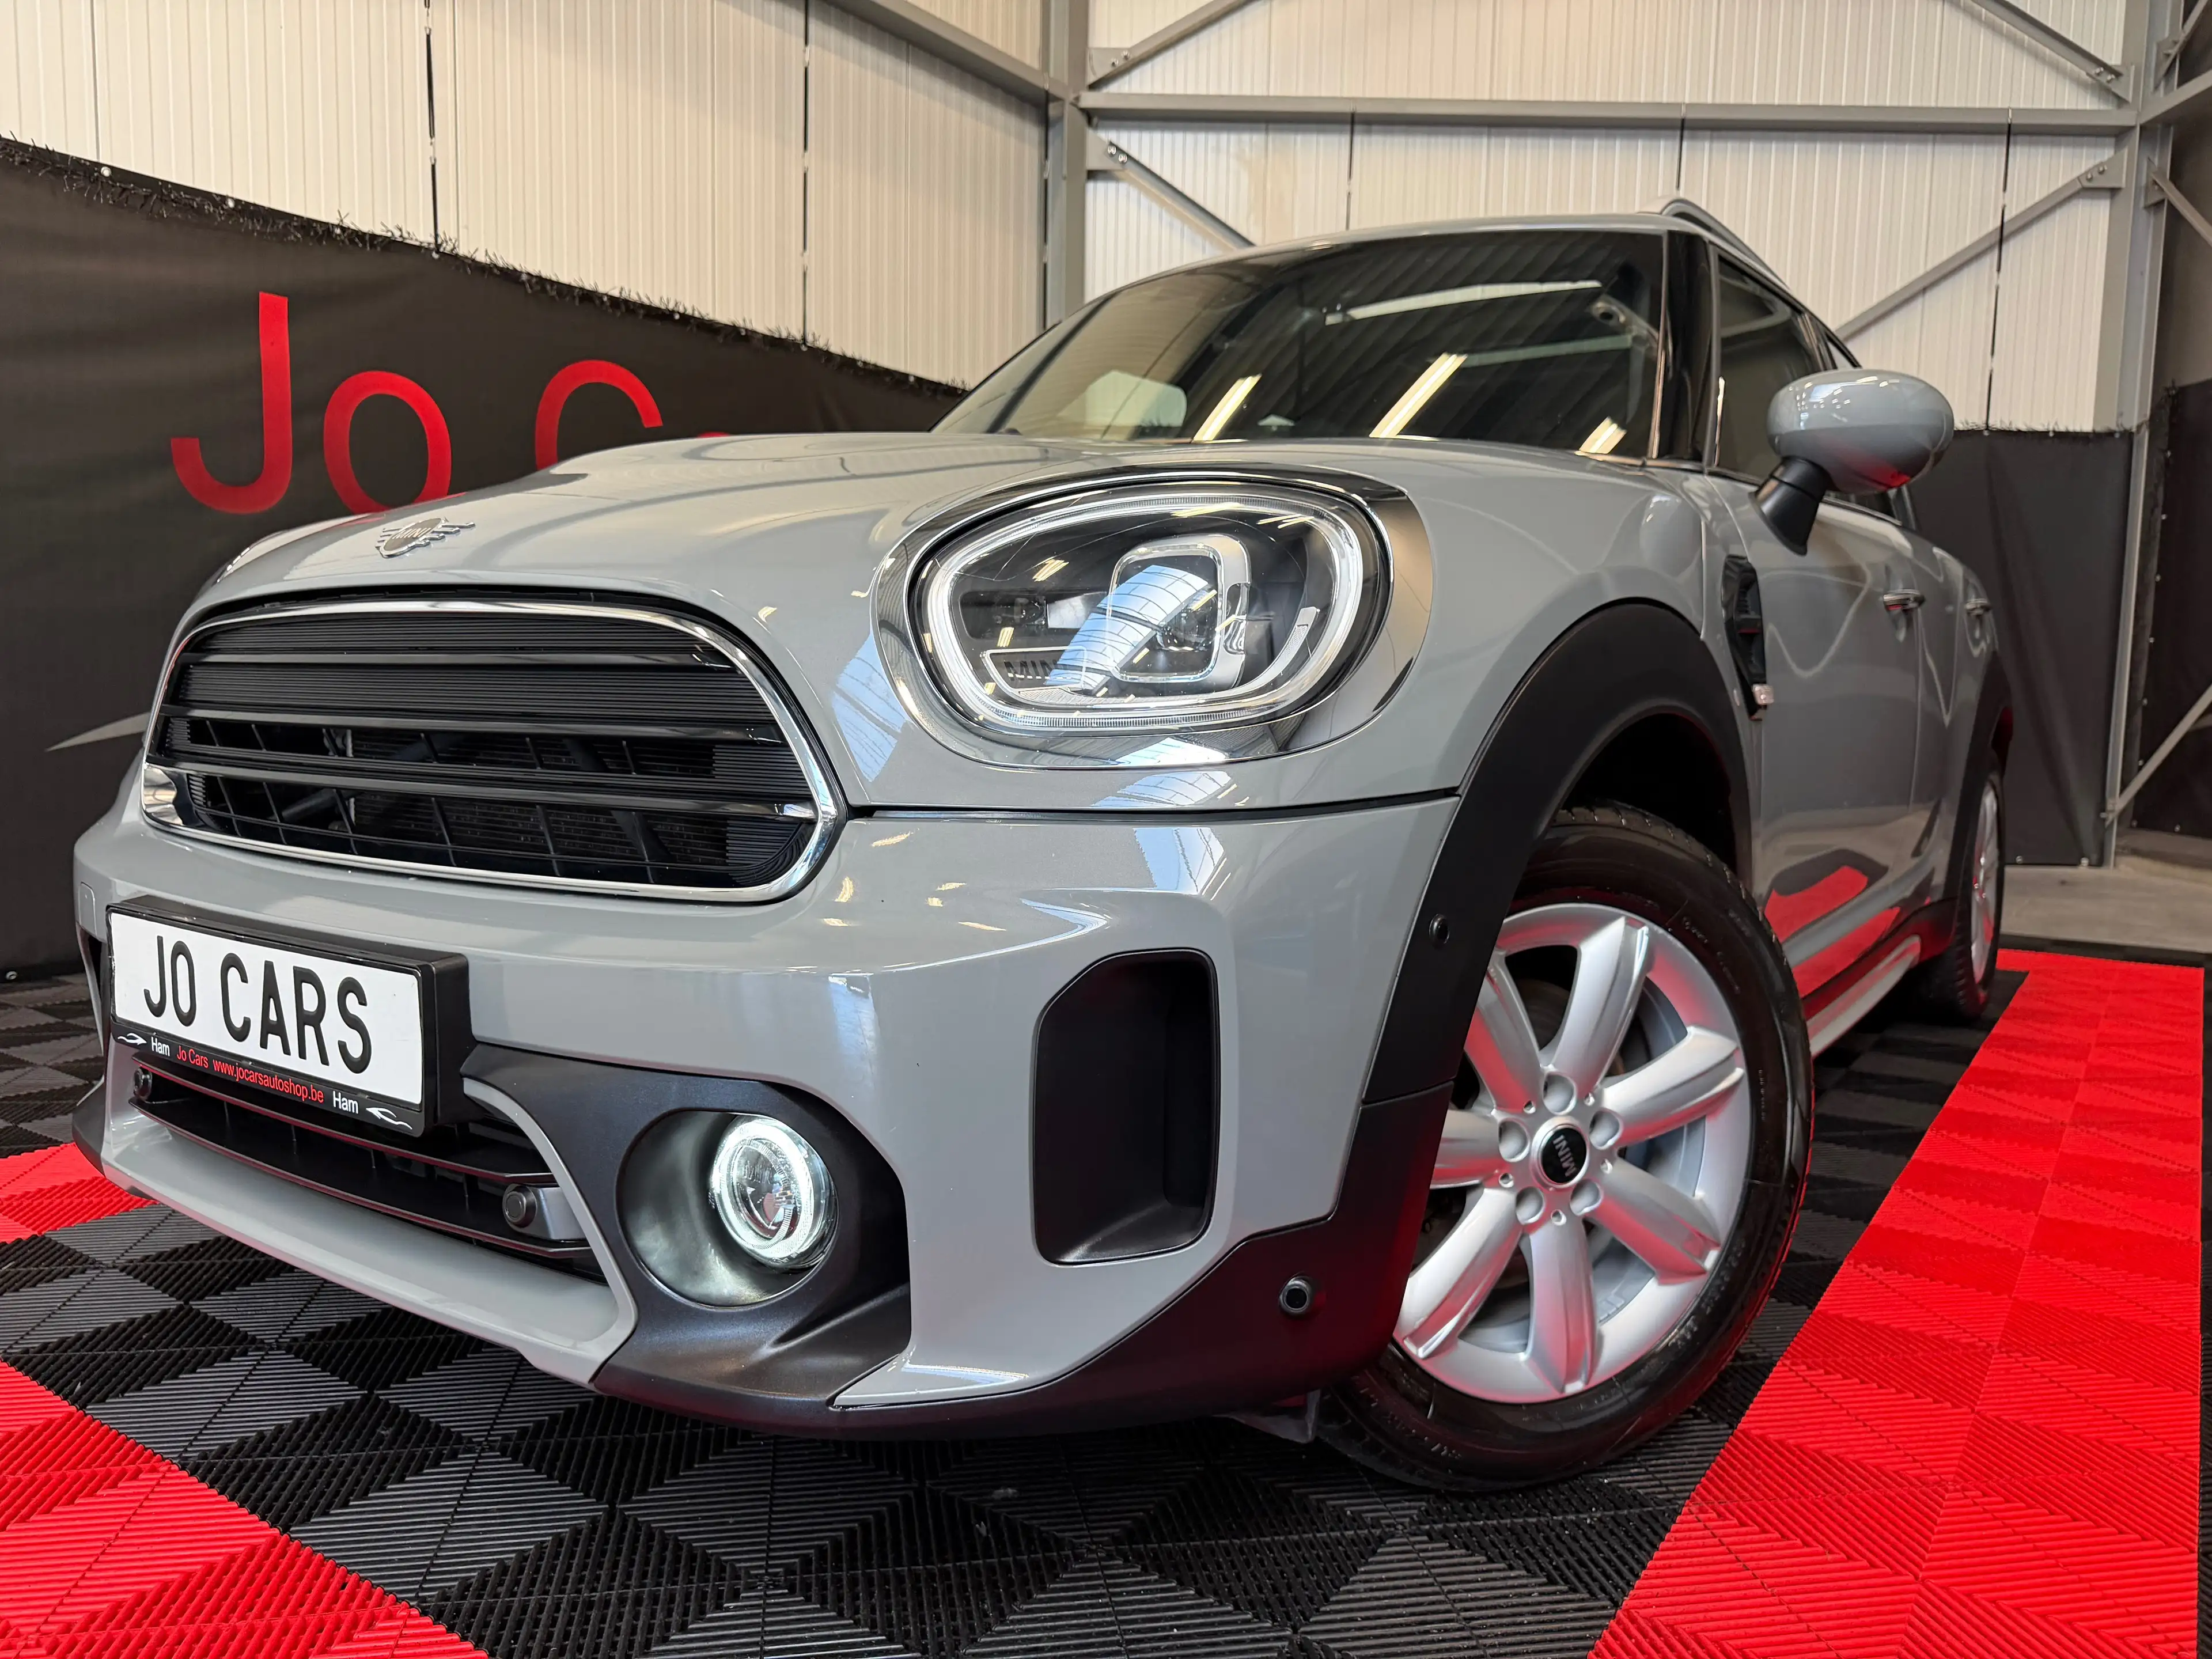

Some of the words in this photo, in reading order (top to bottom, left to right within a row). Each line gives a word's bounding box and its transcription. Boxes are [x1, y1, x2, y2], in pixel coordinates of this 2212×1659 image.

[171, 290, 452, 515] Jo
[391, 528, 431, 539] MINI
[144, 935, 196, 1027] JO
[221, 953, 372, 1074] CARS
[151, 1037, 170, 1056] Ham
[177, 1046, 187, 1062] Jo
[188, 1048, 209, 1069] Cars
[213, 1060, 324, 1103] www.jocarsautoshop.be
[332, 1091, 359, 1114] Ham
[1553, 1135, 1577, 1177] MINI
